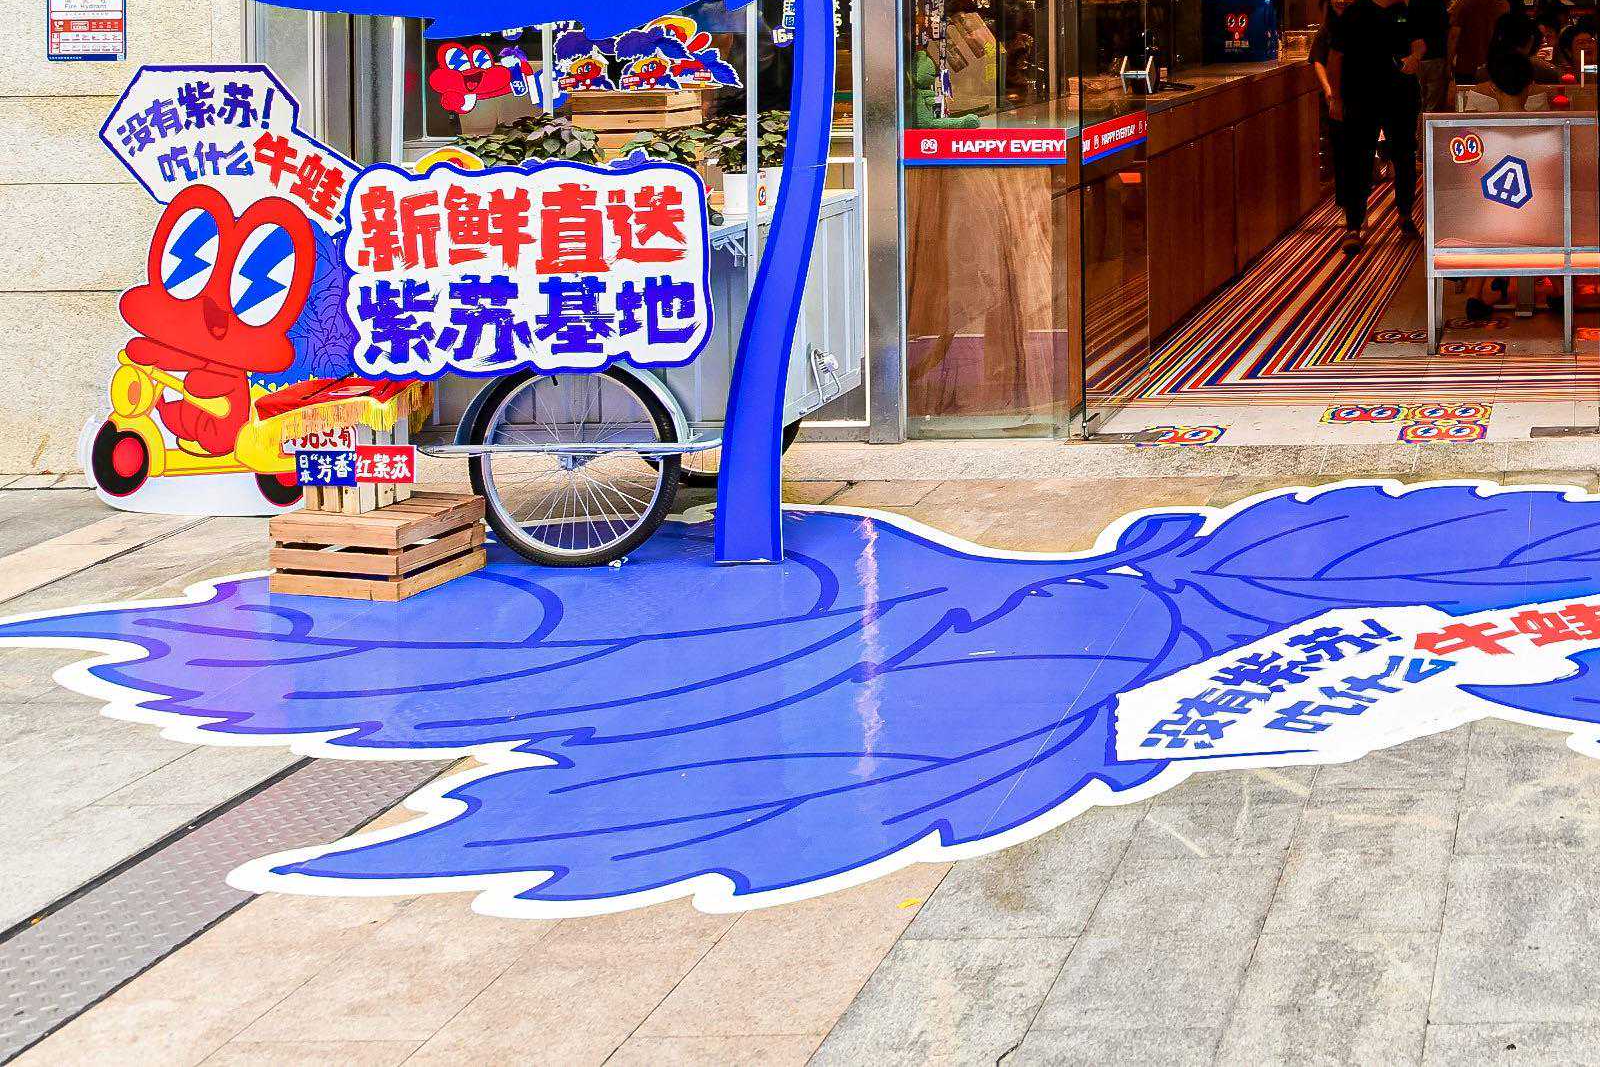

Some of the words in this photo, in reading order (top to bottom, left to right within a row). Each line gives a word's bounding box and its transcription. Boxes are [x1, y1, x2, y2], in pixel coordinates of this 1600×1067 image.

[116, 81, 275, 154] 没有紫苏!
[951, 139, 1007, 153] HAPPY
[1010, 139, 1067, 152] EVERY
[158, 131, 348, 224] 吃什么牛蛙
[356, 183, 688, 275] 新鲜直送
[356, 274, 697, 366] 紫苏基地
